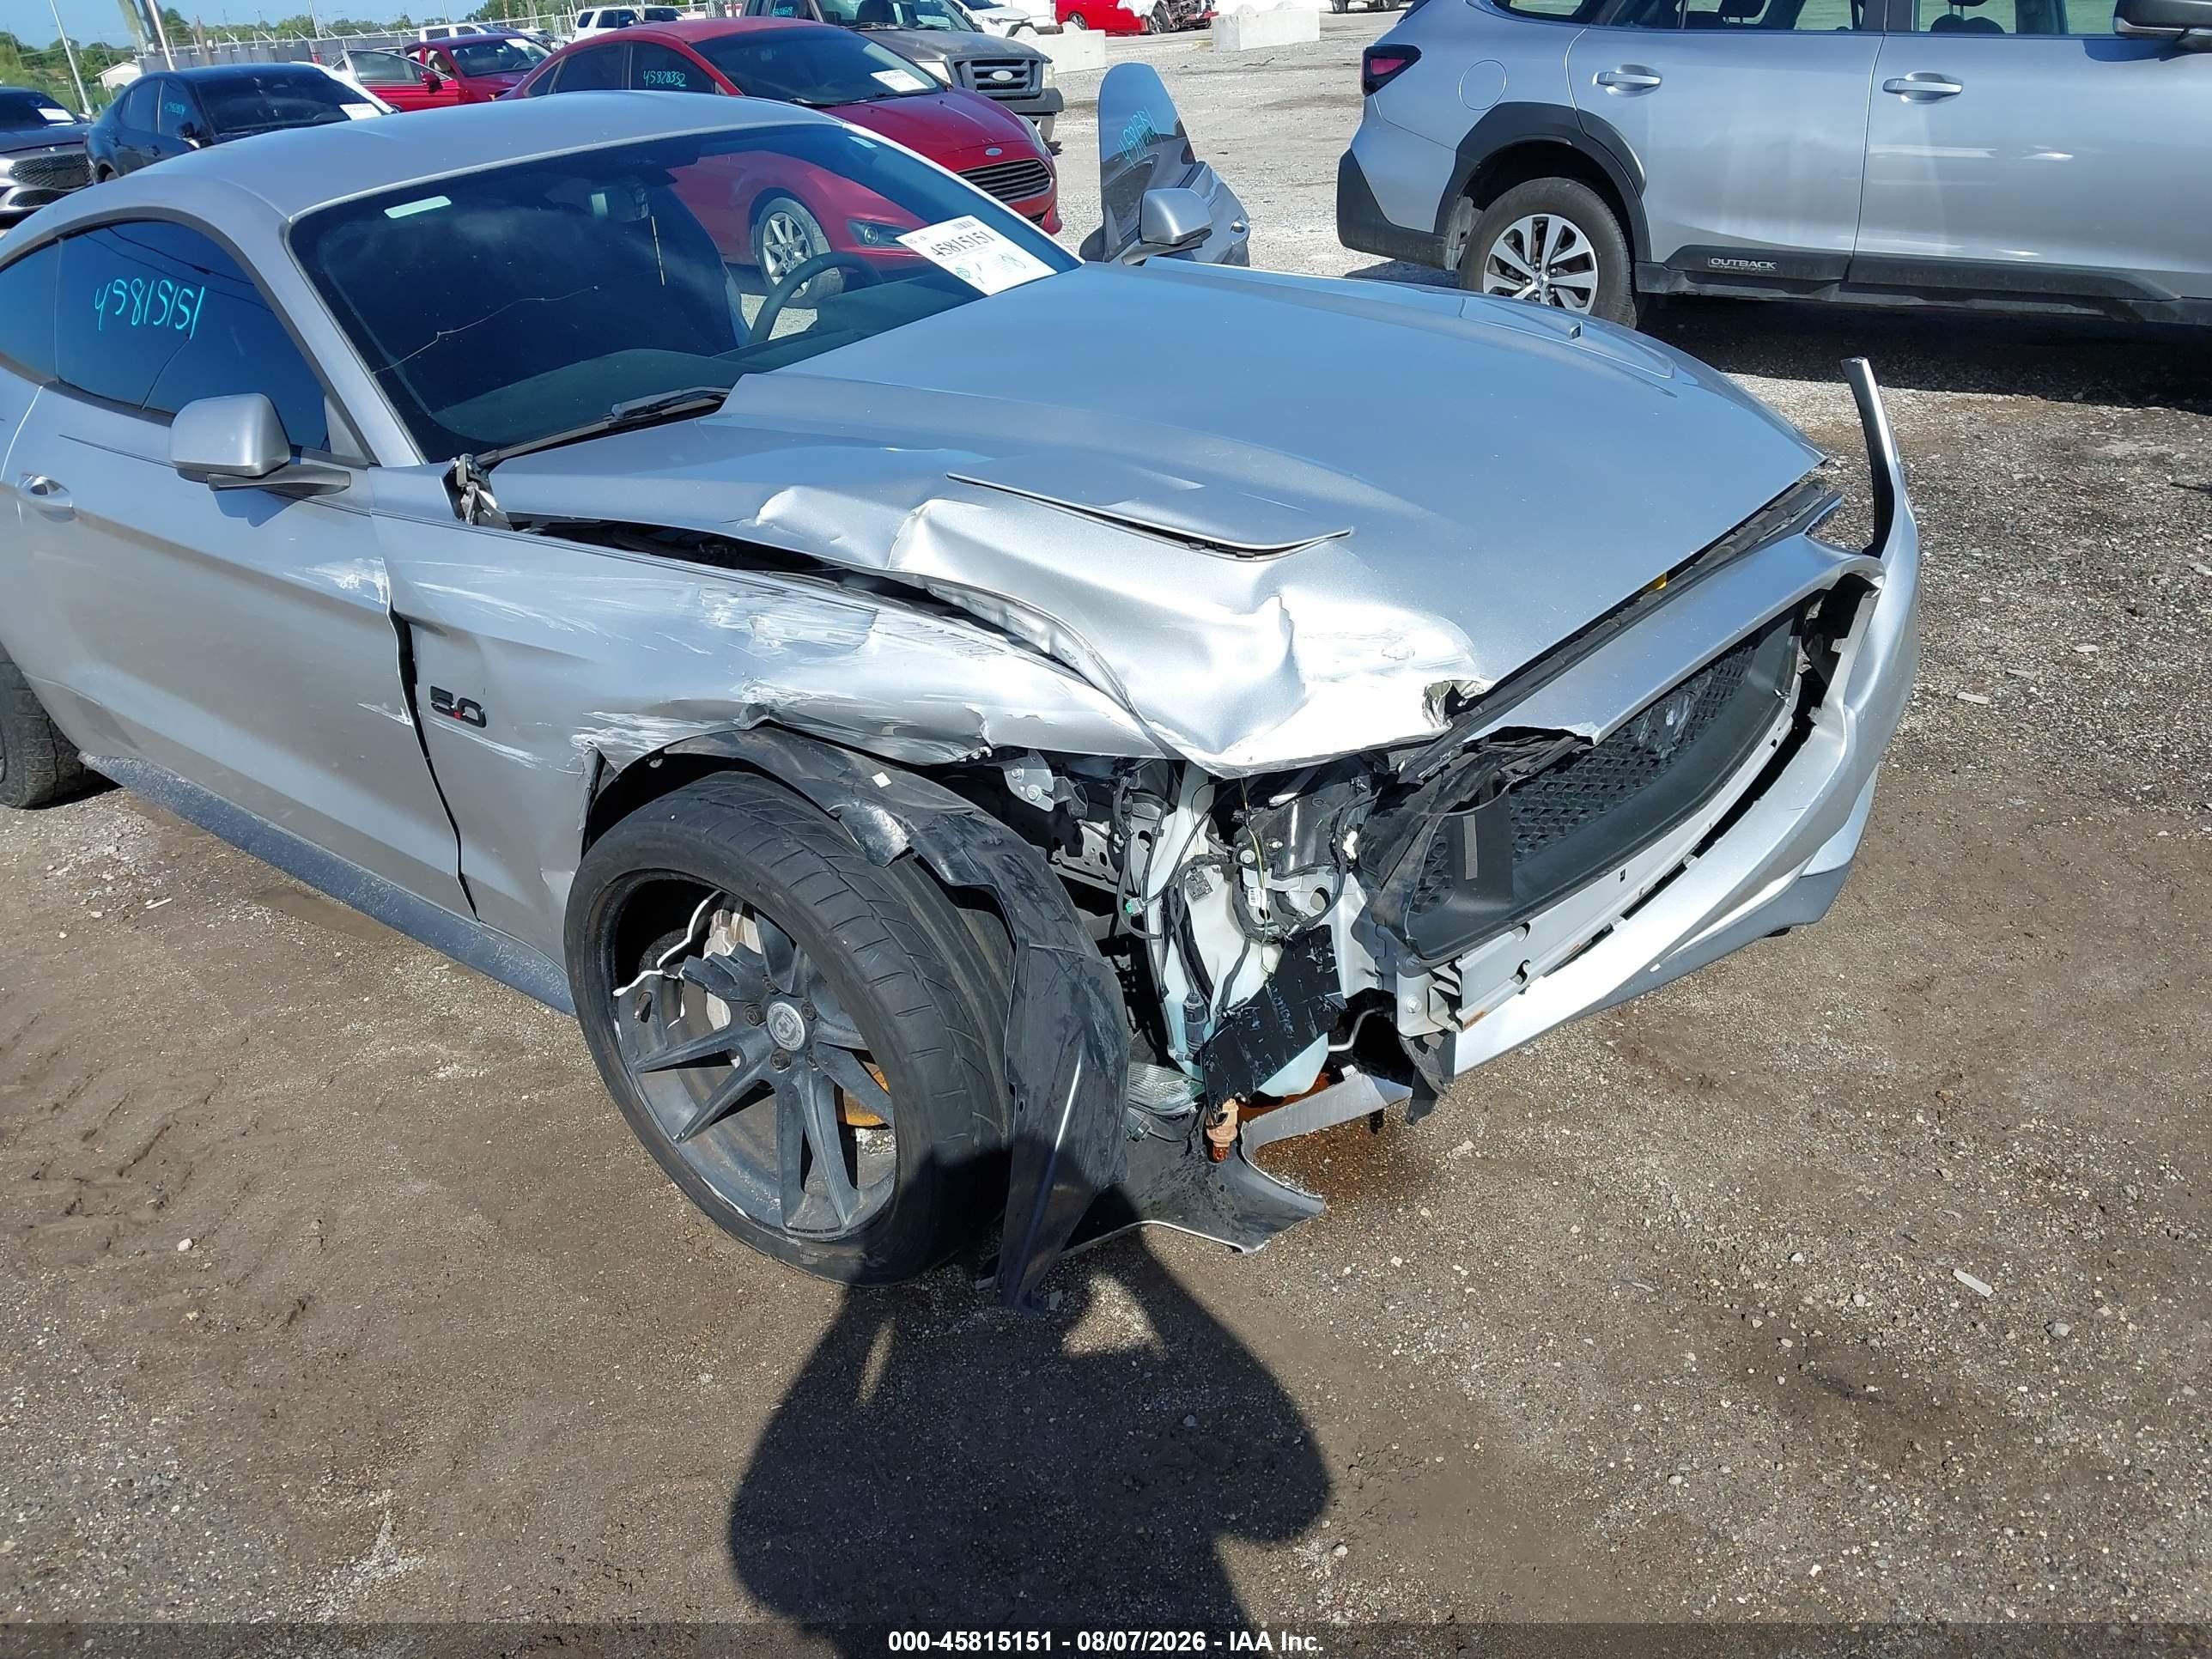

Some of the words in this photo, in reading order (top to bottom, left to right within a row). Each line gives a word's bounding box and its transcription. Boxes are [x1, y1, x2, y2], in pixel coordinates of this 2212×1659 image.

[643, 70, 687, 87] 45828332
[930, 231, 996, 257] 45815151
[1711, 258, 1778, 270] OUTBACK
[94, 277, 205, 340] 45815151
[429, 685, 487, 728] 5.0
